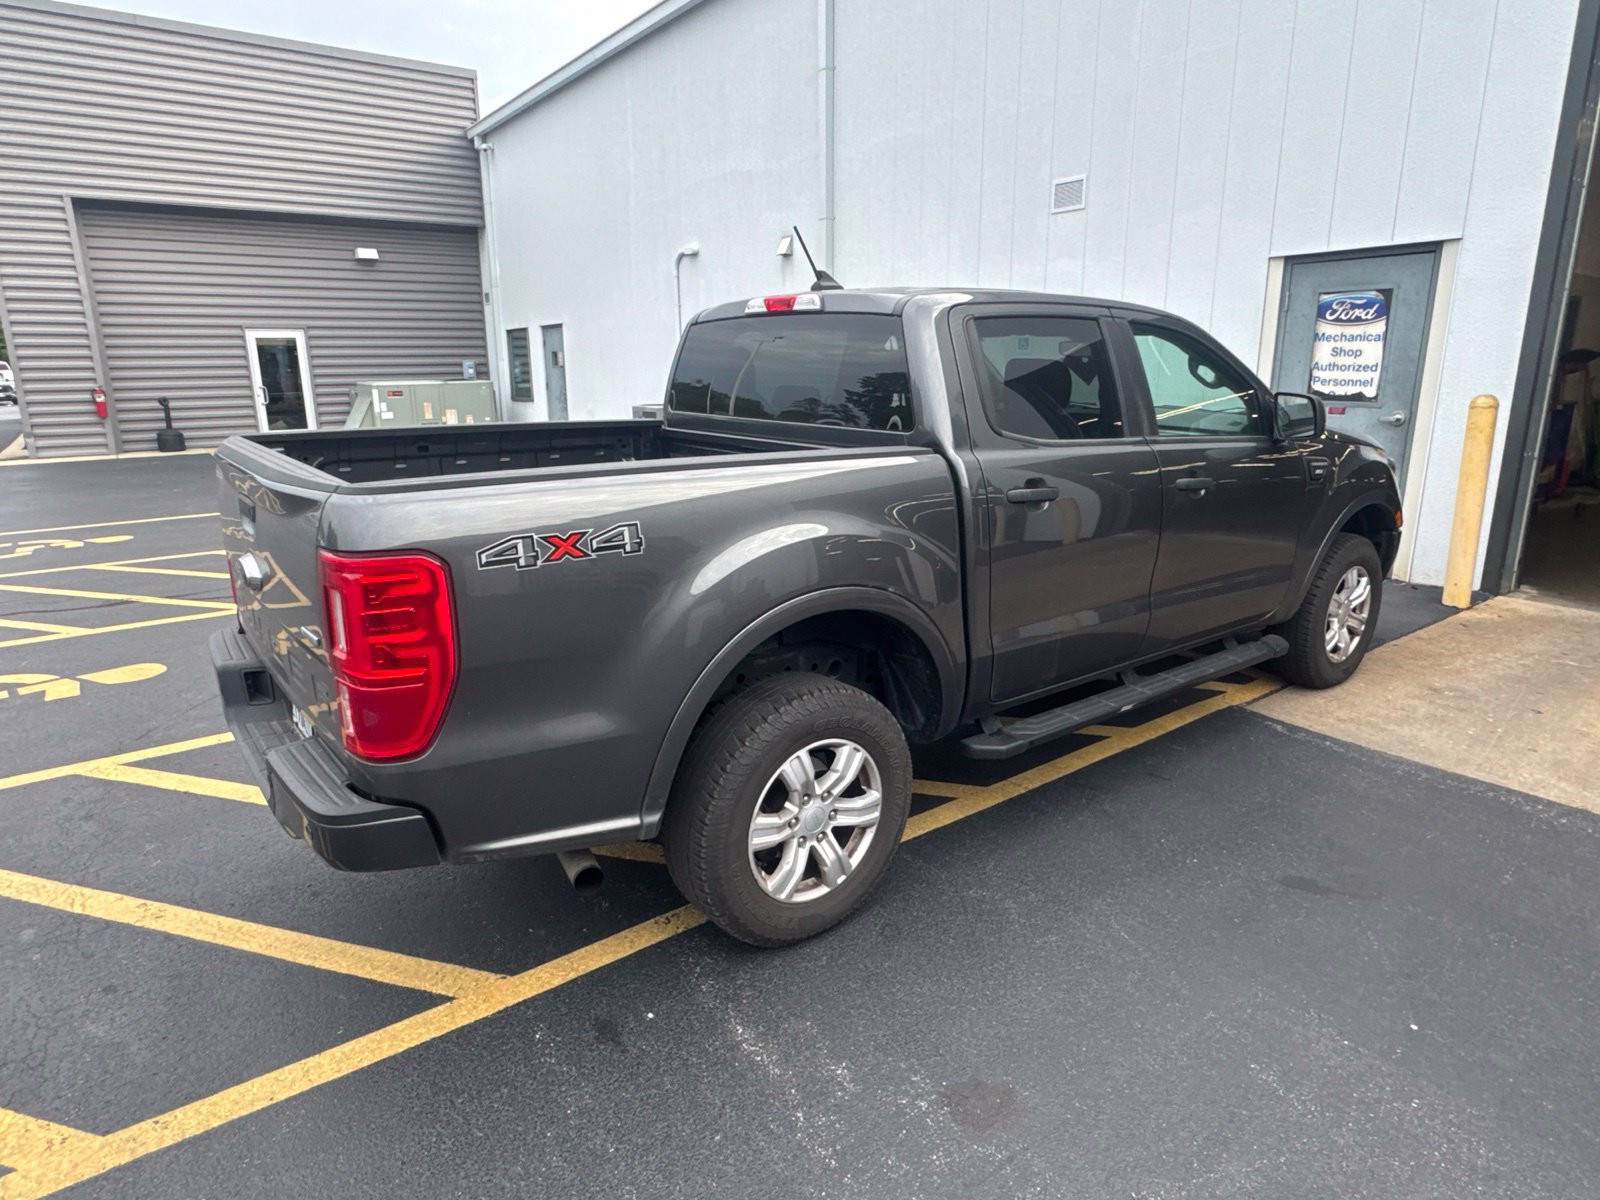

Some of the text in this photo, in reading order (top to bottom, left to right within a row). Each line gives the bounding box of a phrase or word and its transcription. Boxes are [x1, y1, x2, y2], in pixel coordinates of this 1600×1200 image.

[1325, 298, 1379, 320] Ford
[1314, 332, 1386, 342] Mechanical
[1331, 347, 1362, 358] Shop
[1312, 361, 1378, 372] Authorized
[1312, 376, 1374, 387] Personnel
